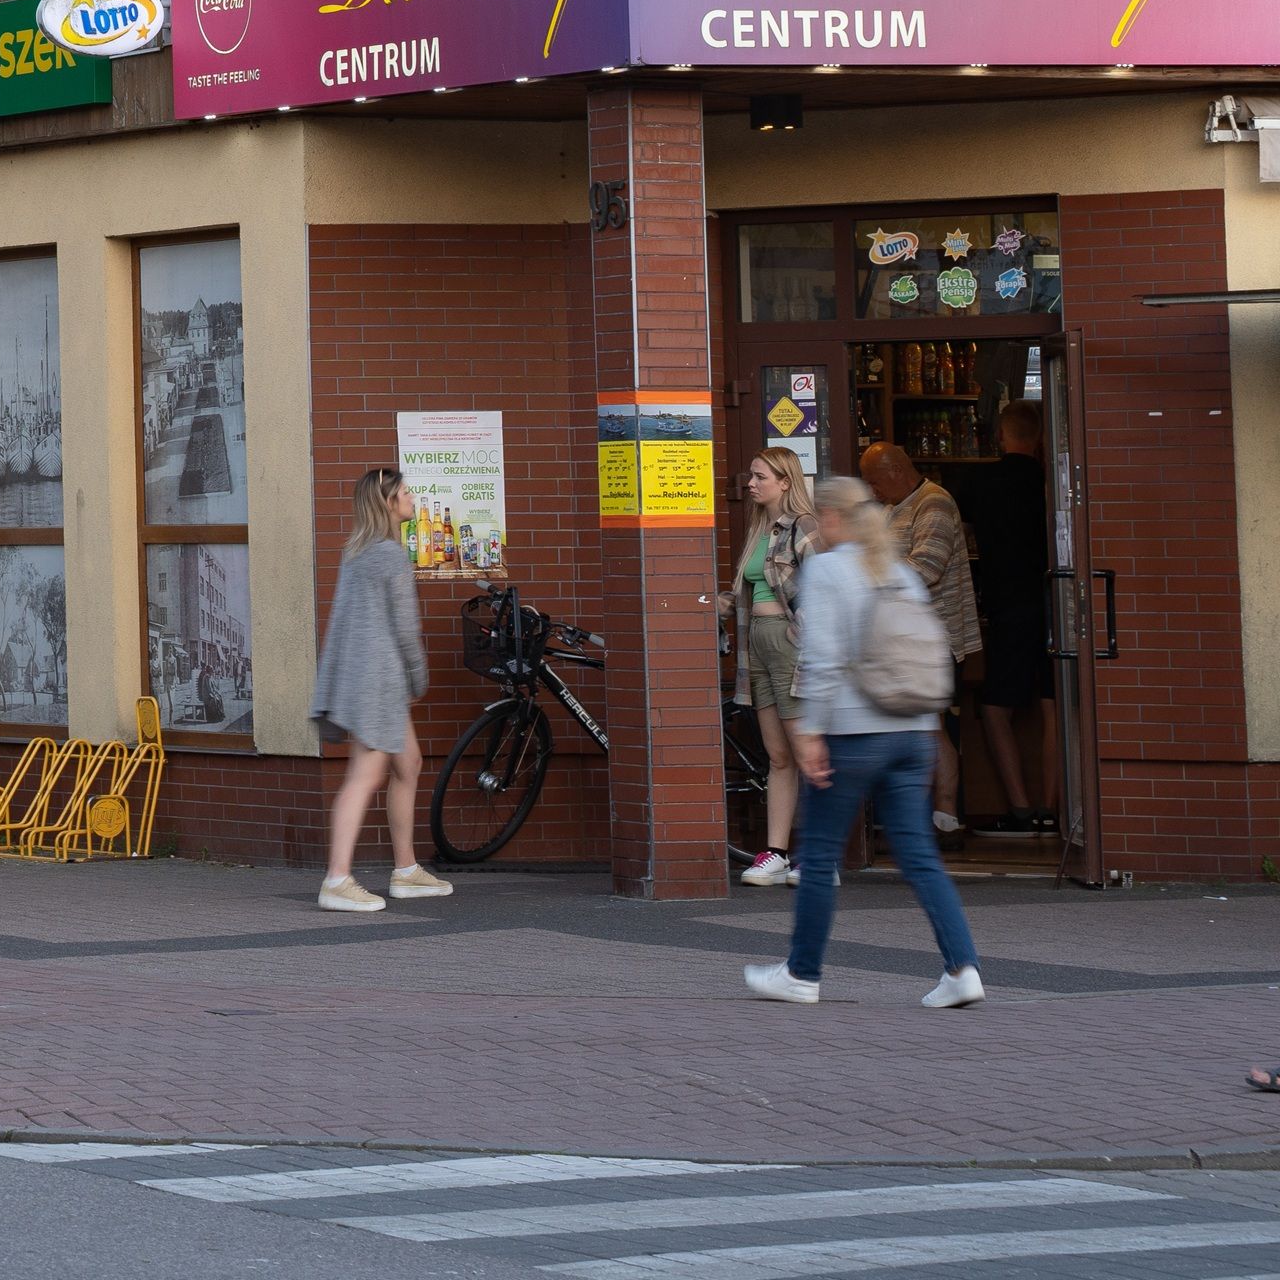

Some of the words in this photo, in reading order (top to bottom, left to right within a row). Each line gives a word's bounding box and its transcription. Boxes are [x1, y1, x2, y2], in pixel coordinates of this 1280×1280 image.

[79, 2, 139, 36] LOTTO
[700, 8, 927, 49] CENTRUM
[319, 36, 442, 88] CENTRUM
[187, 74, 212, 89] TASTE
[212, 71, 228, 86] THE
[229, 68, 261, 84] FEELING
[589, 180, 627, 232] 95
[879, 238, 908, 257] LOTTO
[939, 276, 975, 288] Ekstra
[403, 452, 460, 464] WYBIERZ
[461, 449, 500, 465] MOC
[443, 465, 501, 475] ORZEŹWIENIA
[407, 485, 428, 494] KUP
[428, 484, 438, 496] 4
[461, 482, 495, 491] ODBIERZ
[461, 491, 495, 501] GRATIS
